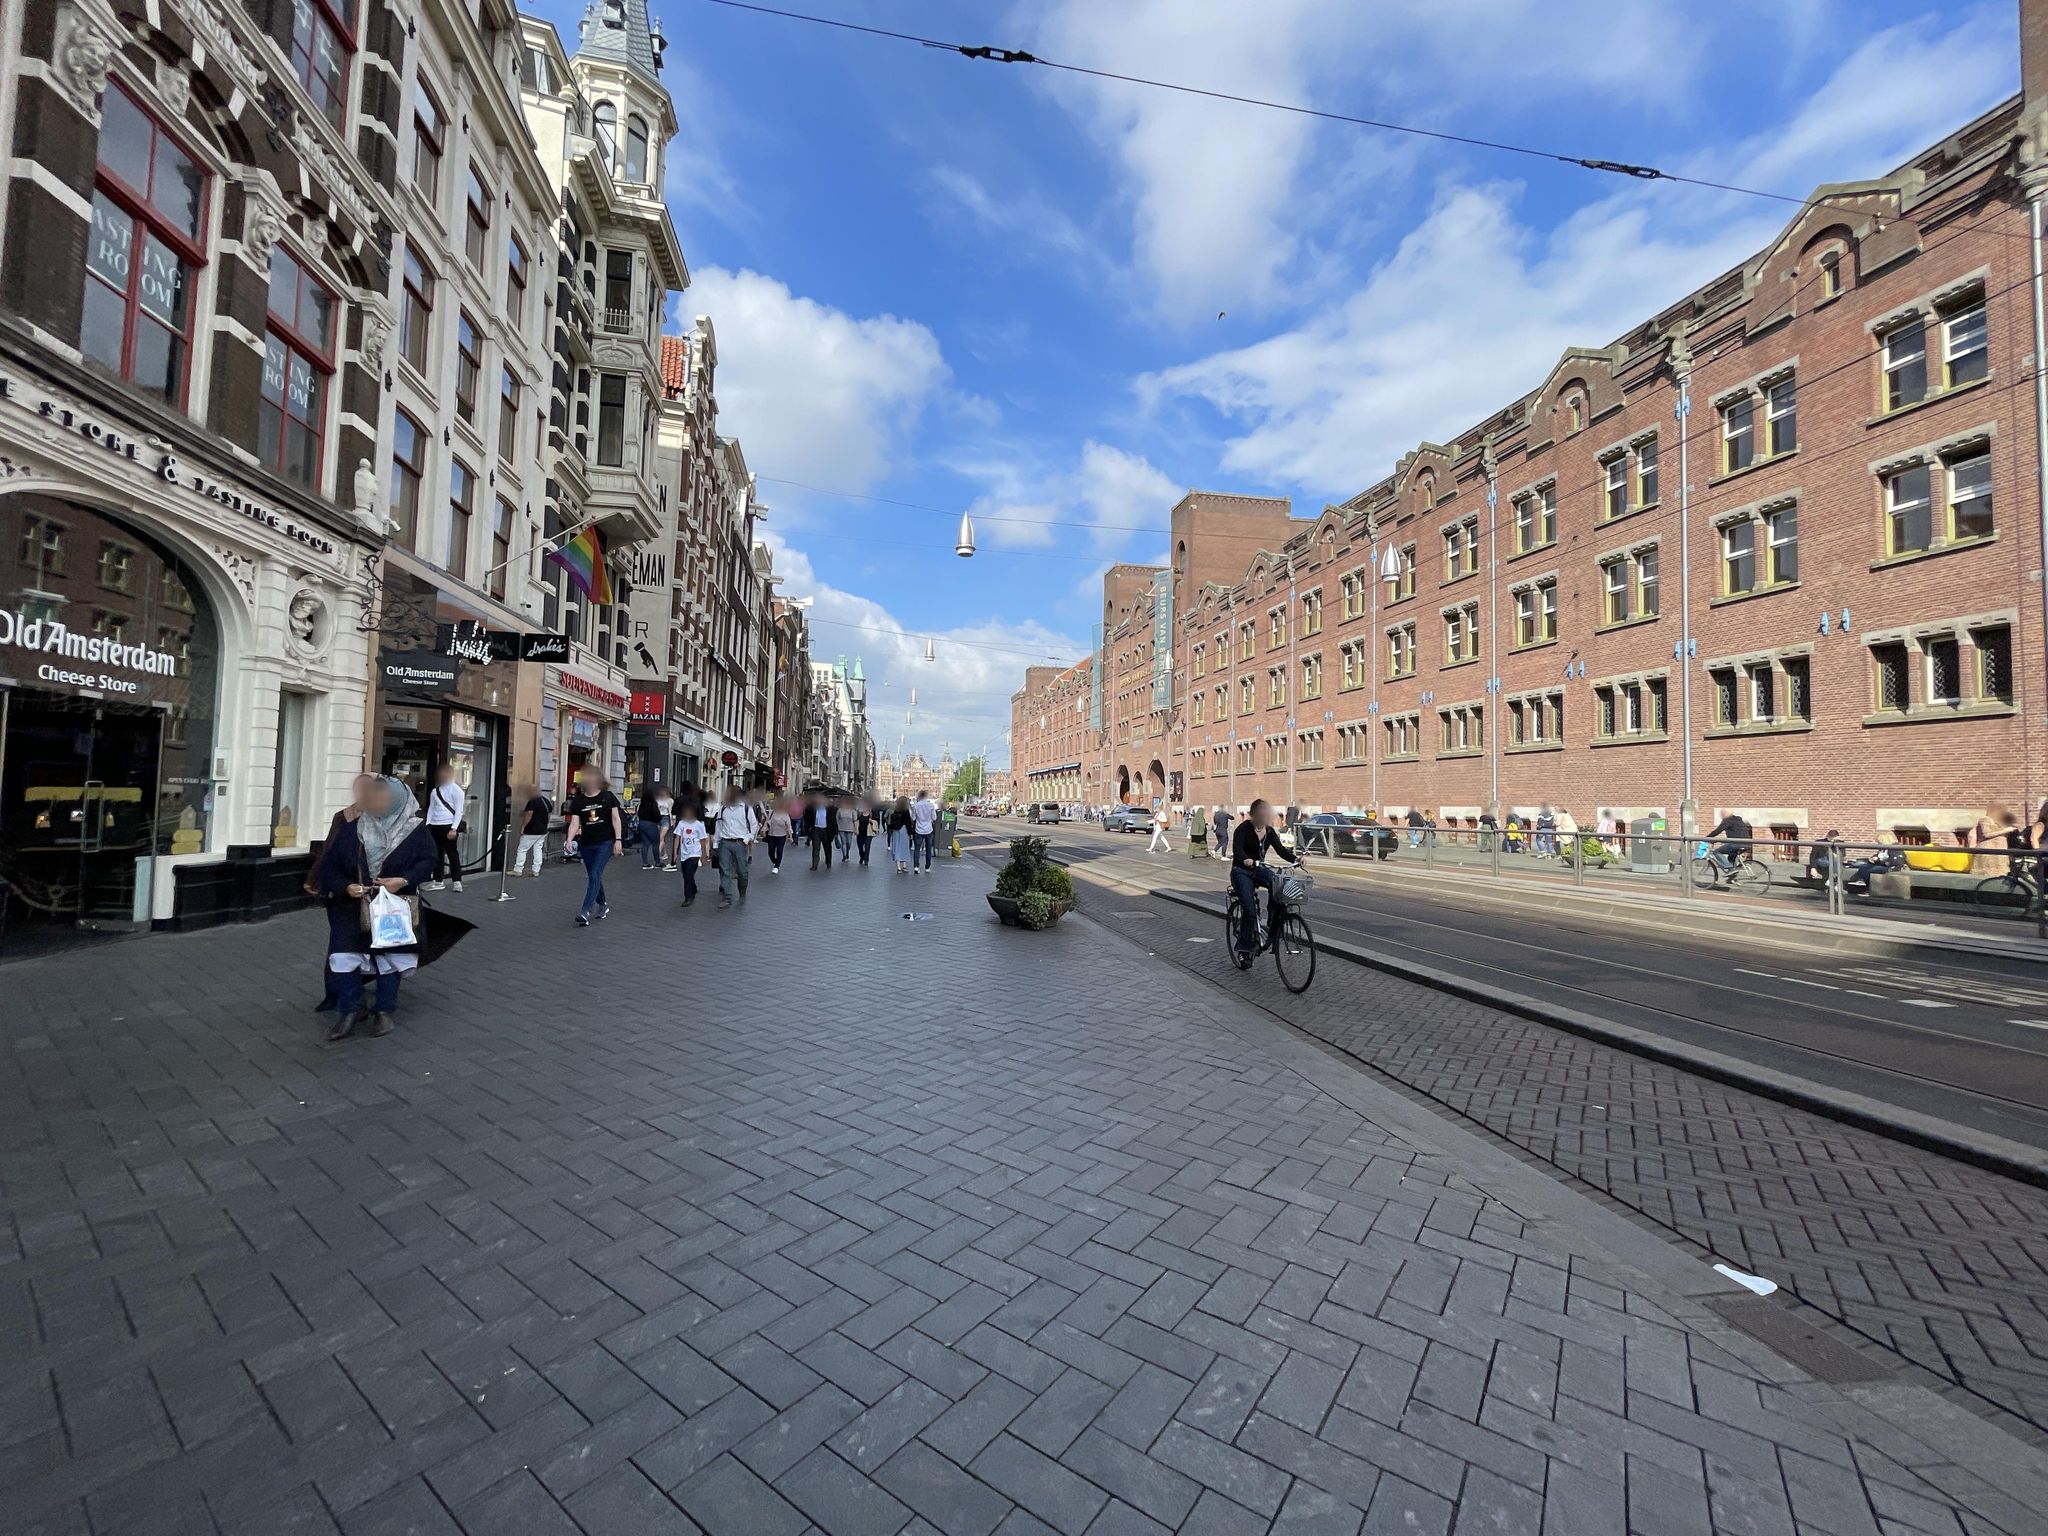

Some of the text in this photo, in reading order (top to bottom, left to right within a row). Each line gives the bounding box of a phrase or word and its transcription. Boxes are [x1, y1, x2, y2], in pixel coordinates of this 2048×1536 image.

[265, 364, 309, 409] ROOM
[38, 401, 142, 461] STORE
[193, 477, 280, 528] TASTING
[286, 524, 333, 554] ROOM
[1159, 586, 1167, 620] BEURS
[0, 609, 176, 677] Old Amsterdam
[1159, 622, 1167, 644] VAN
[38, 664, 137, 694] Cheese Store
[386, 665, 454, 680] Old Amsterdam
[632, 713, 660, 721] BAZAR
